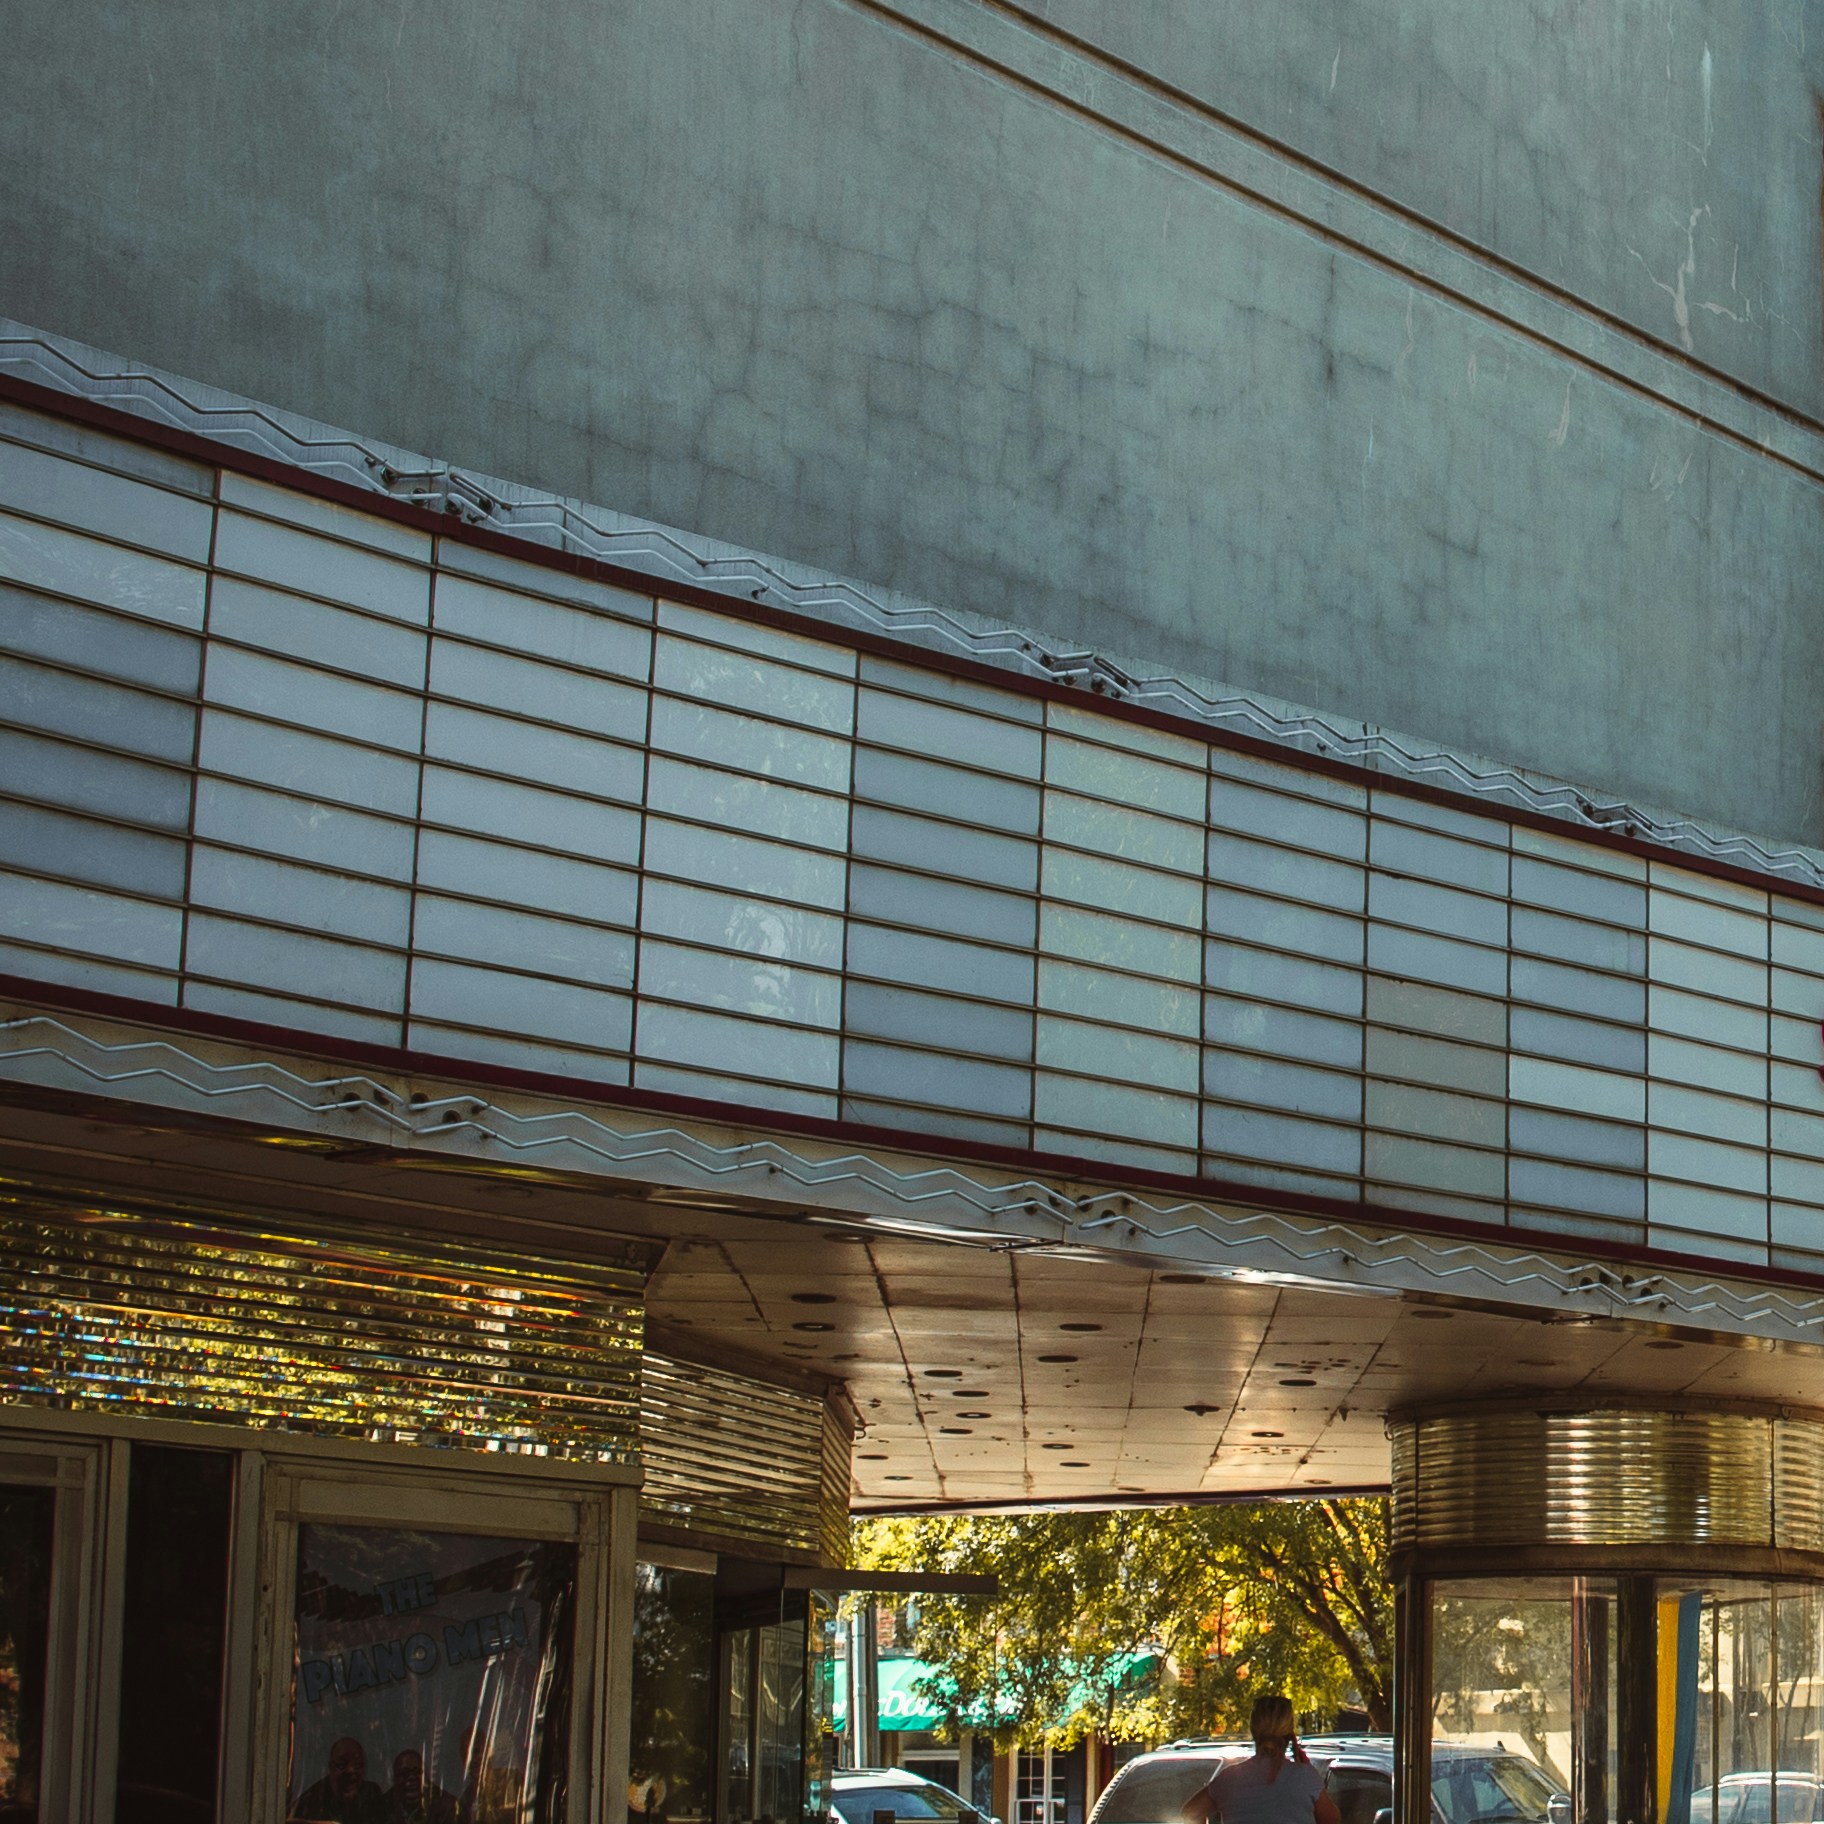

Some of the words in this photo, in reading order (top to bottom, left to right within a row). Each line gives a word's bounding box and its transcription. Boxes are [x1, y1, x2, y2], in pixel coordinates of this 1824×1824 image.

[374, 1572, 437, 1616] THE
[301, 1632, 437, 1703] PIANO
[443, 1607, 528, 1665] MEN
